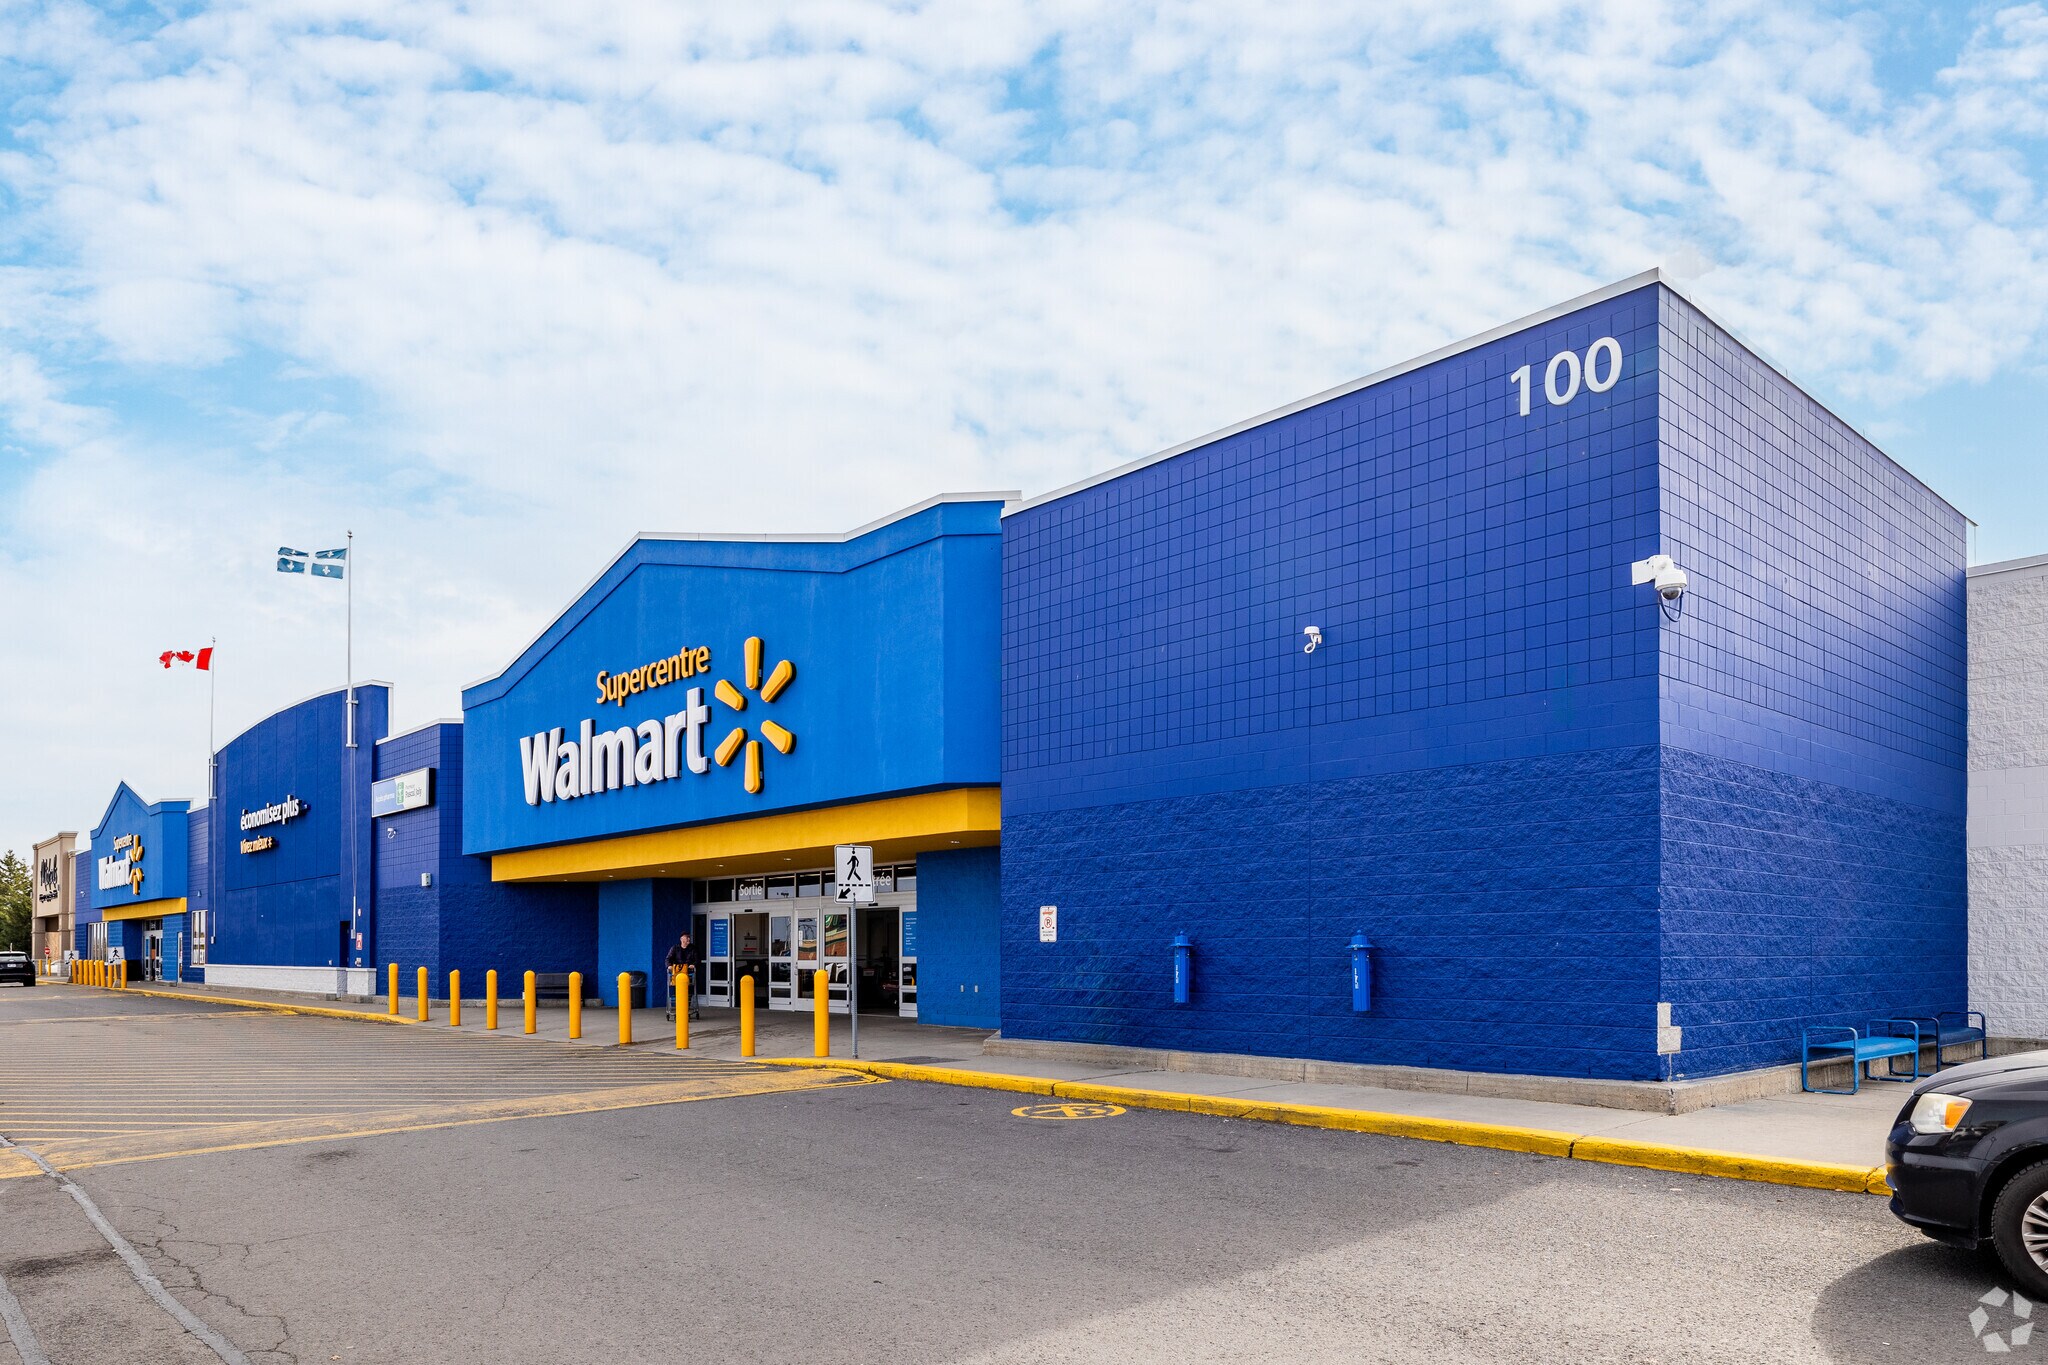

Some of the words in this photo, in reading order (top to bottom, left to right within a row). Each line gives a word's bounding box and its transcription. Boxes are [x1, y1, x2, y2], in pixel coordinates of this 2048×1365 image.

[1510, 336, 1623, 417] 100
[596, 645, 711, 706] Supercentre
[519, 687, 709, 806] Walmart
[98, 850, 131, 891] Walmart
[739, 883, 763, 896] Sortie
[873, 872, 892, 886] trée
